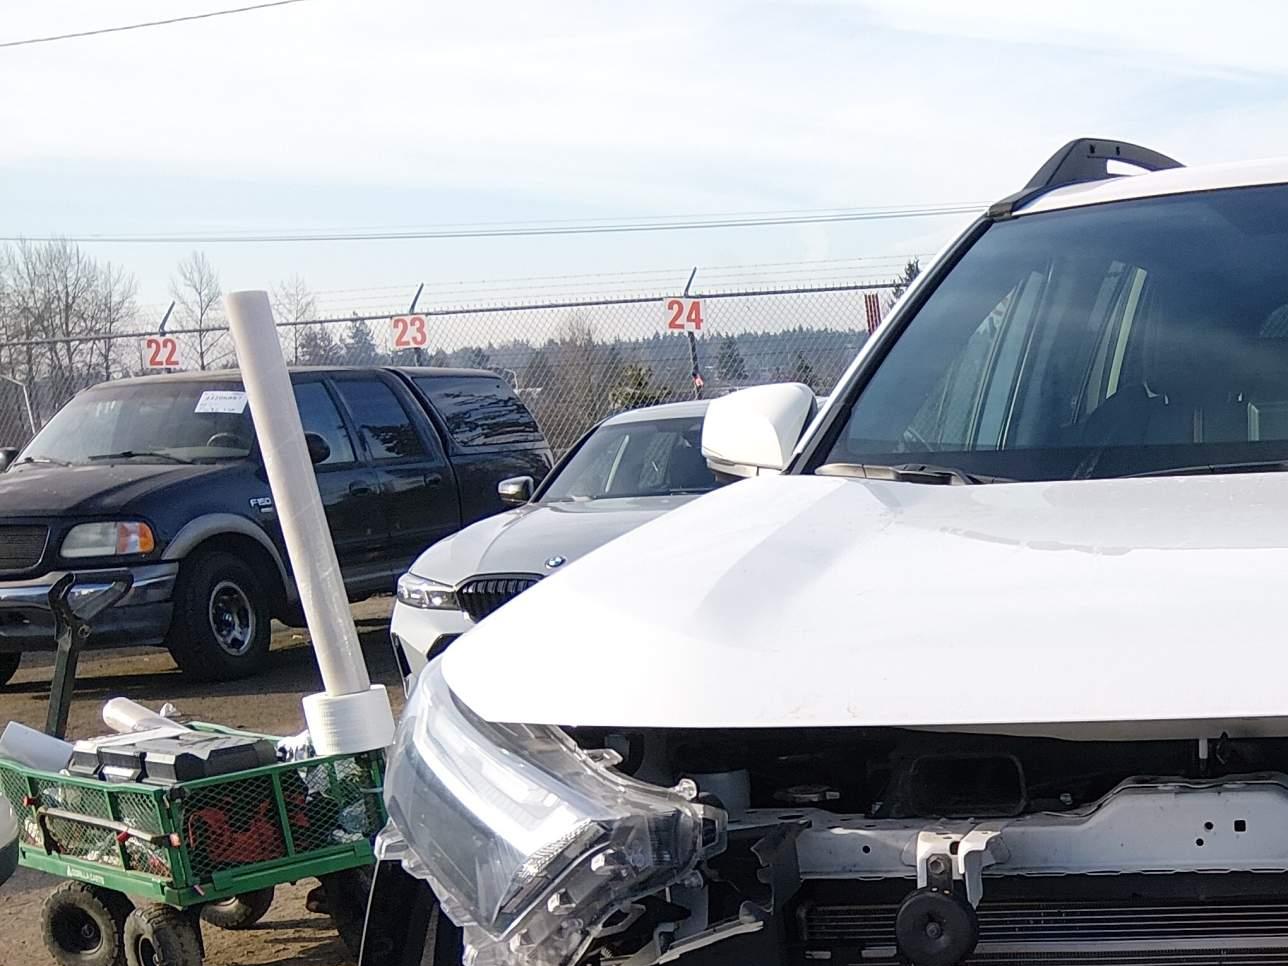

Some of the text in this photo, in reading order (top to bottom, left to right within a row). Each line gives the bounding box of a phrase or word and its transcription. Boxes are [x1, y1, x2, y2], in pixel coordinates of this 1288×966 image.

[667, 299, 704, 330] 24
[393, 316, 428, 347] 23
[146, 337, 179, 366] 22
